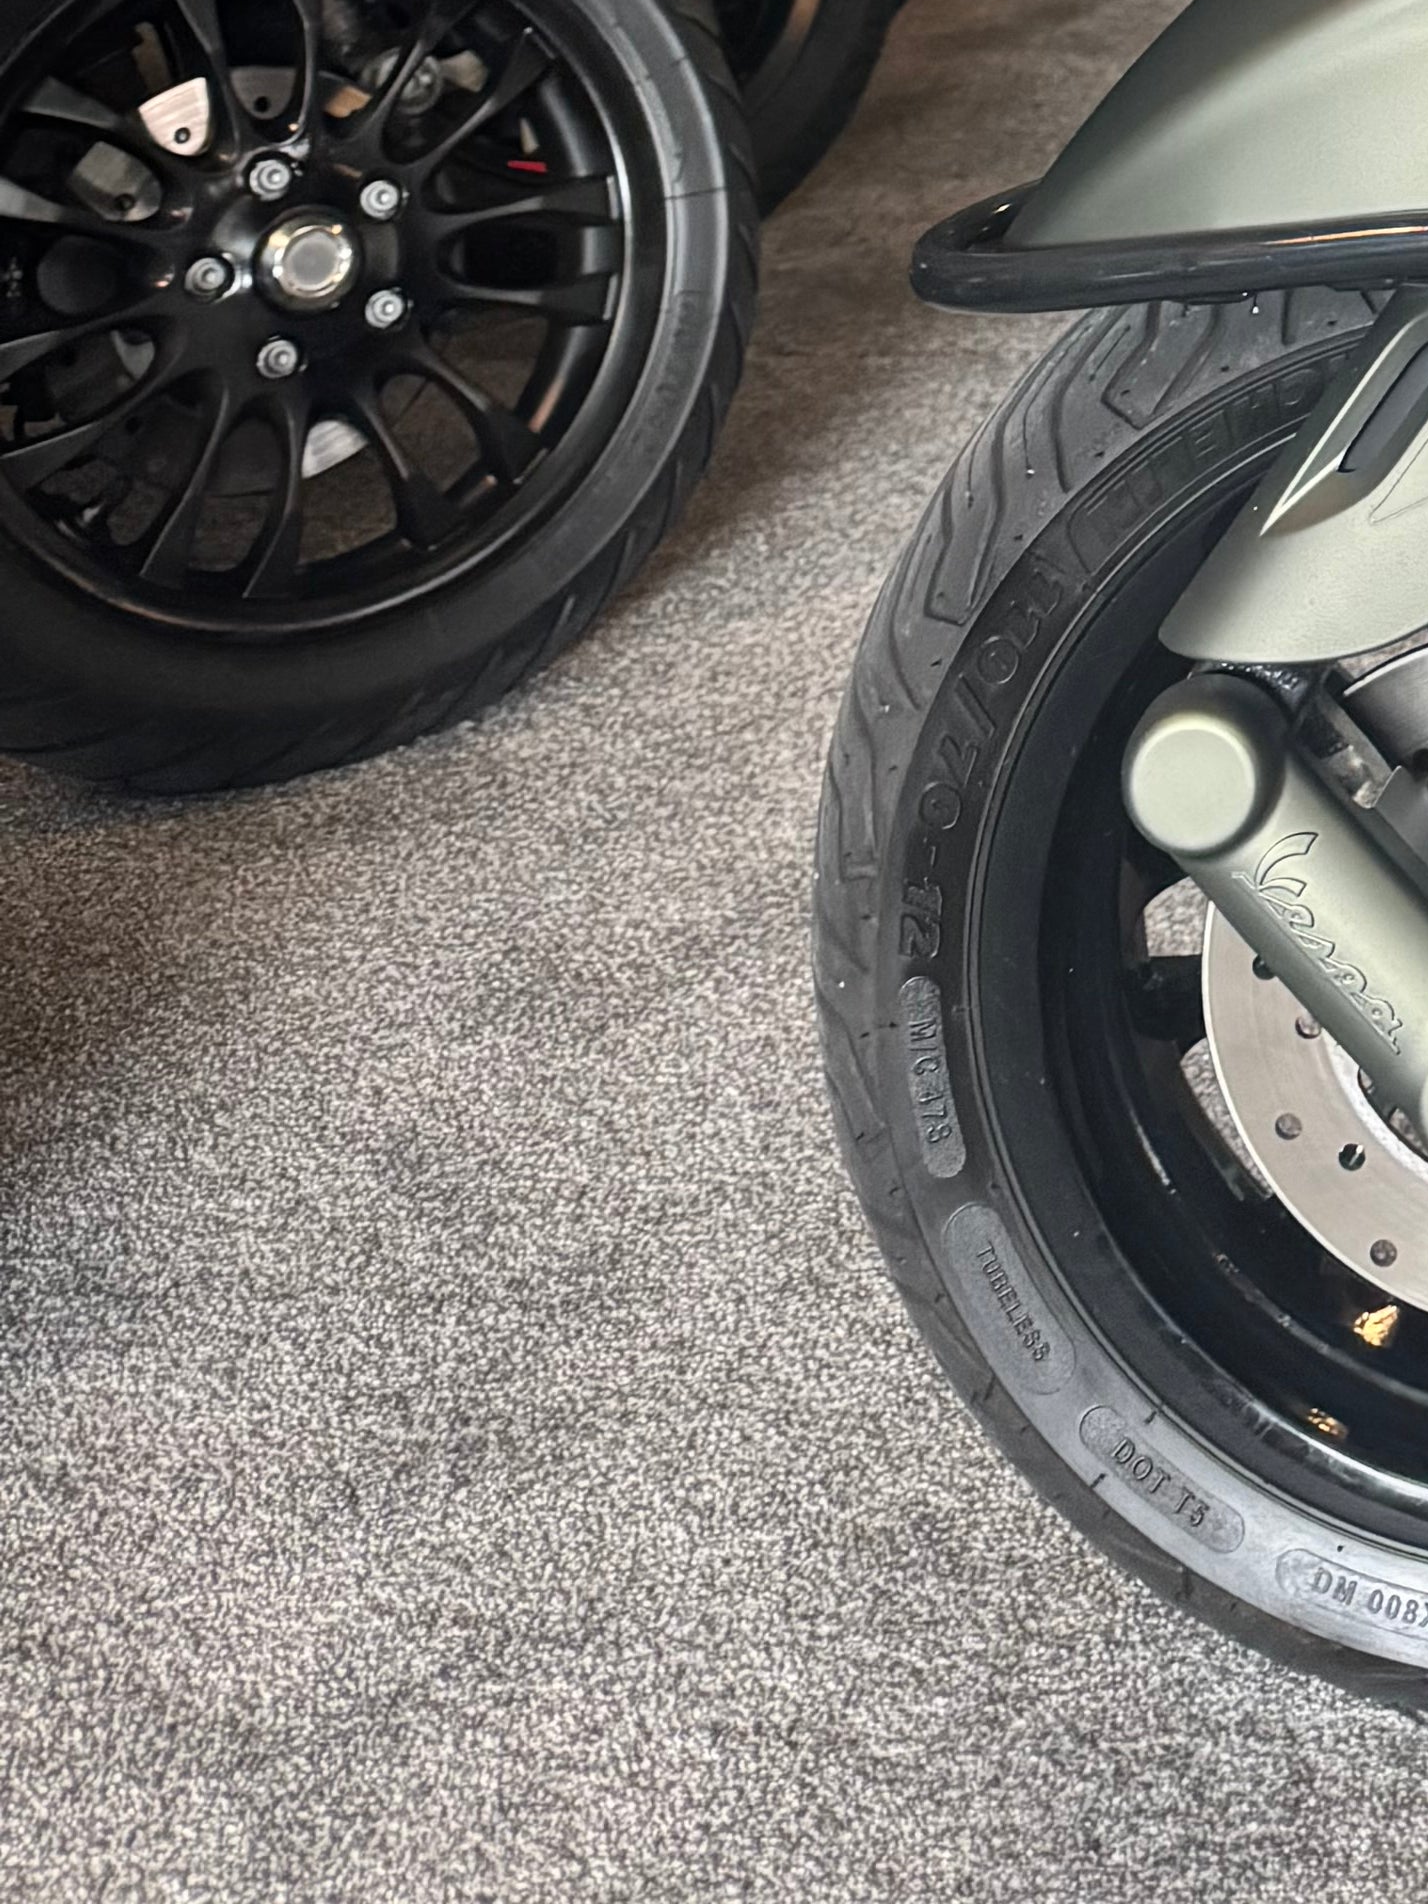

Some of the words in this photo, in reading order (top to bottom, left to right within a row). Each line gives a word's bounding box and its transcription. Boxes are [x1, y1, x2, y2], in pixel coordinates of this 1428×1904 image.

[1230, 830, 1405, 1057] Vespa
[974, 1242, 1052, 1364] TUBELESS
[1110, 1434, 1173, 1502] DOT
[1307, 1564, 1360, 1608] DM
